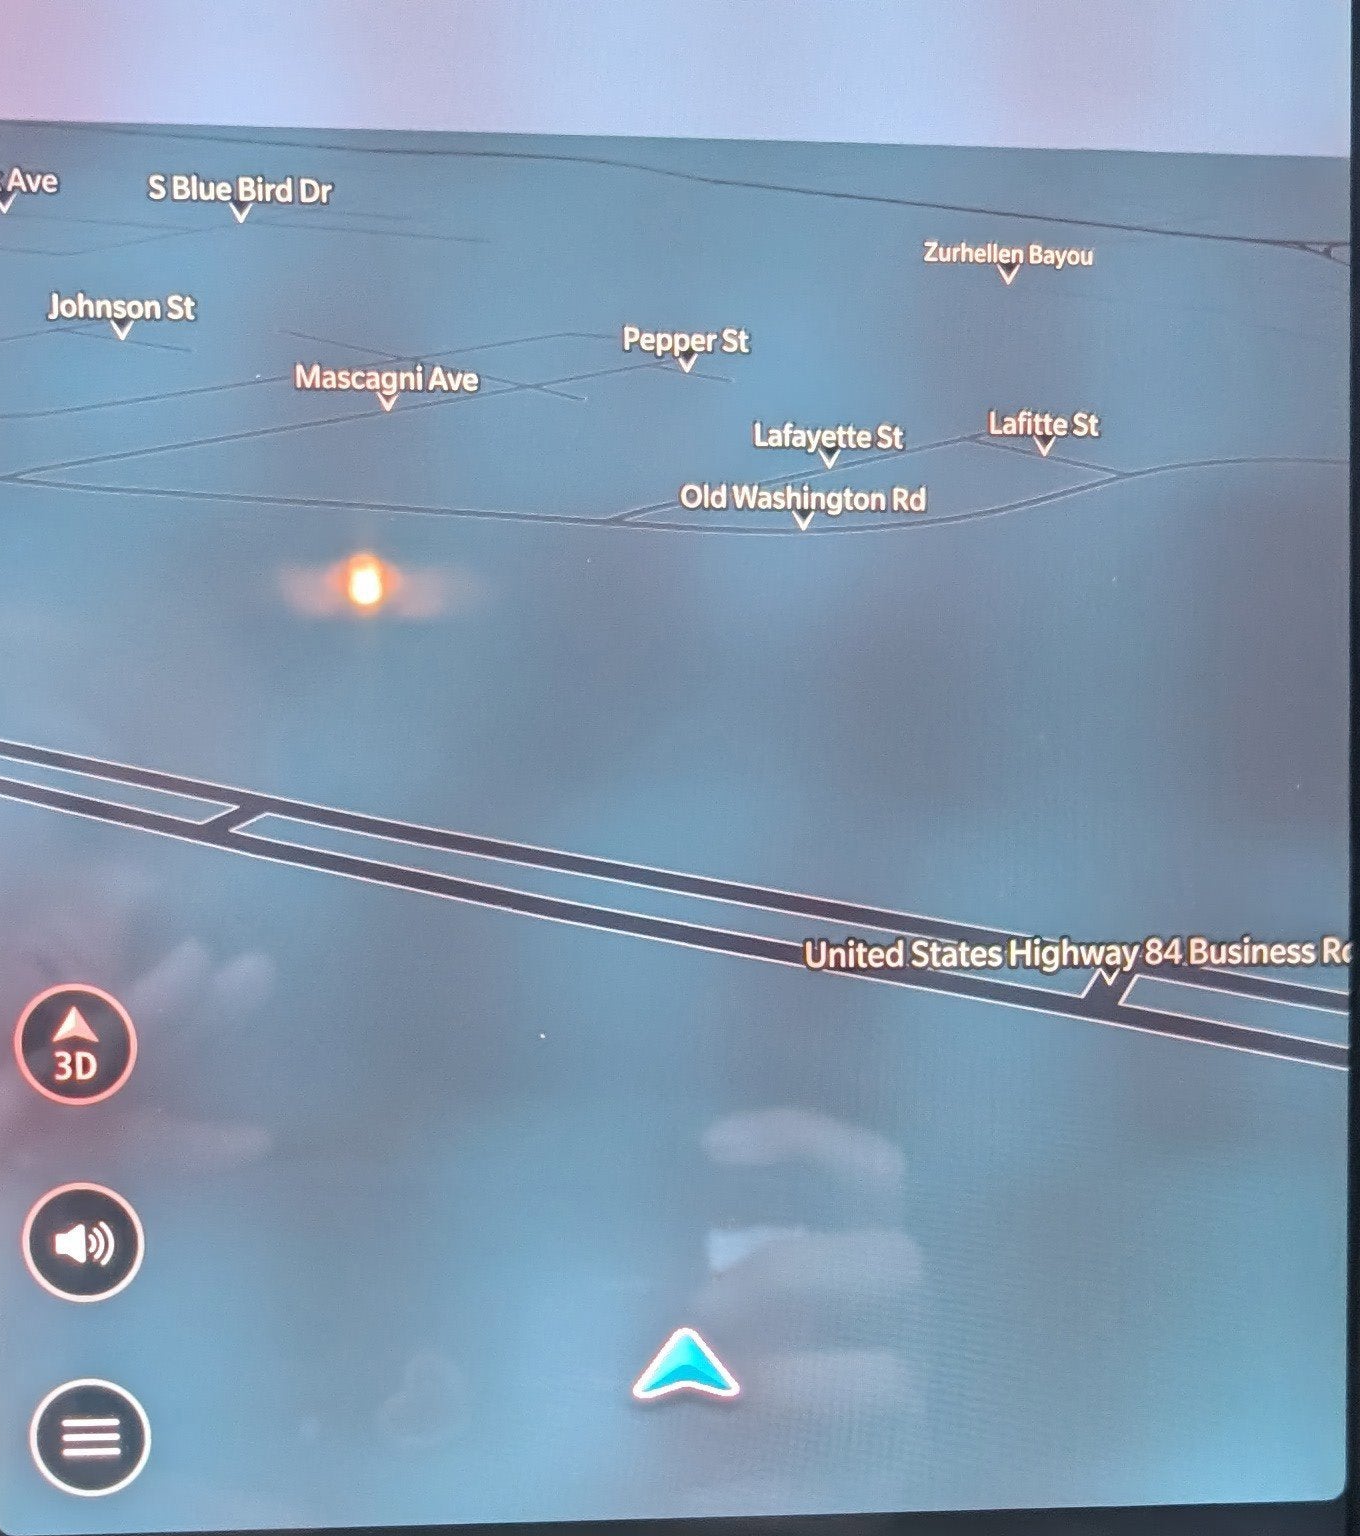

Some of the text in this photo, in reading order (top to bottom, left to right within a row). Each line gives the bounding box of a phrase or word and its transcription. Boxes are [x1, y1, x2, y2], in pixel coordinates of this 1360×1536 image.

[6, 167, 59, 193] Ave
[148, 175, 334, 205] S Blue Bird Dr
[924, 241, 1094, 269] Zurhellen Bayou
[47, 293, 196, 321] Johnson St
[623, 326, 750, 357] Pepper St
[295, 363, 479, 396] Mascagni Ave
[754, 423, 904, 453] Lafayette St
[989, 409, 1101, 438] Lafitte St
[680, 485, 927, 516] Old Washington Rd
[804, 939, 904, 969] United
[911, 939, 1002, 969] States
[1009, 937, 1140, 973] Highway
[1145, 939, 1183, 966] 84
[1190, 937, 1316, 966] Business
[53, 1050, 98, 1082] 3D
